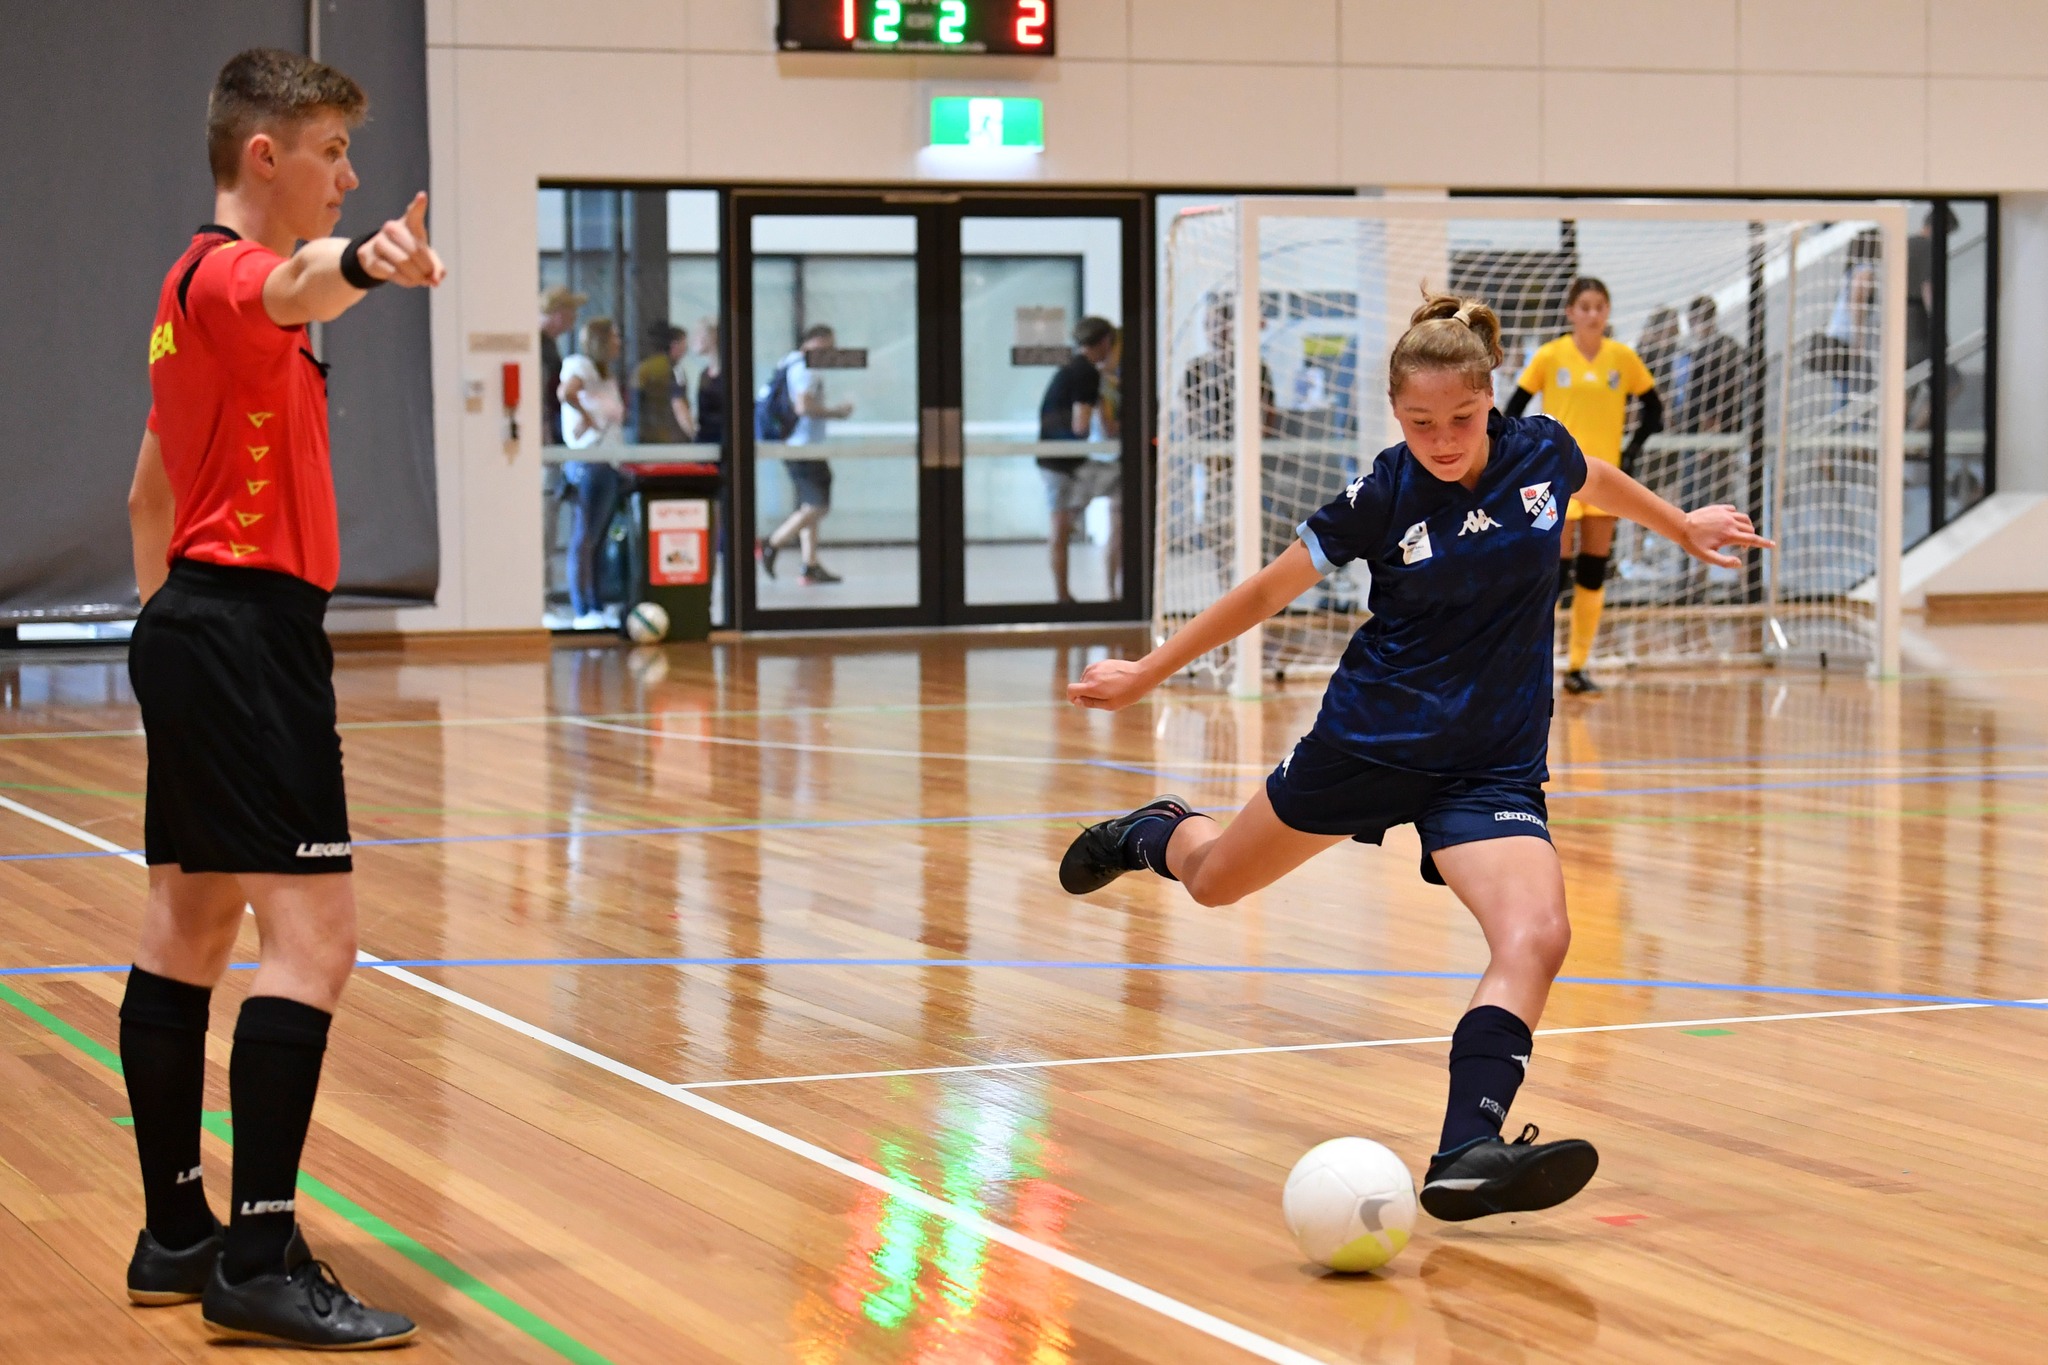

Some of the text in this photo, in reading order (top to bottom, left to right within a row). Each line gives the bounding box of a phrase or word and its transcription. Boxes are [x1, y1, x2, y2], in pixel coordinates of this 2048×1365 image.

[873, 0, 901, 43] 2
[939, 0, 966, 43] 2
[1016, 0, 1046, 45] 2
[149, 321, 177, 364] EA
[1530, 489, 1550, 517] NSW
